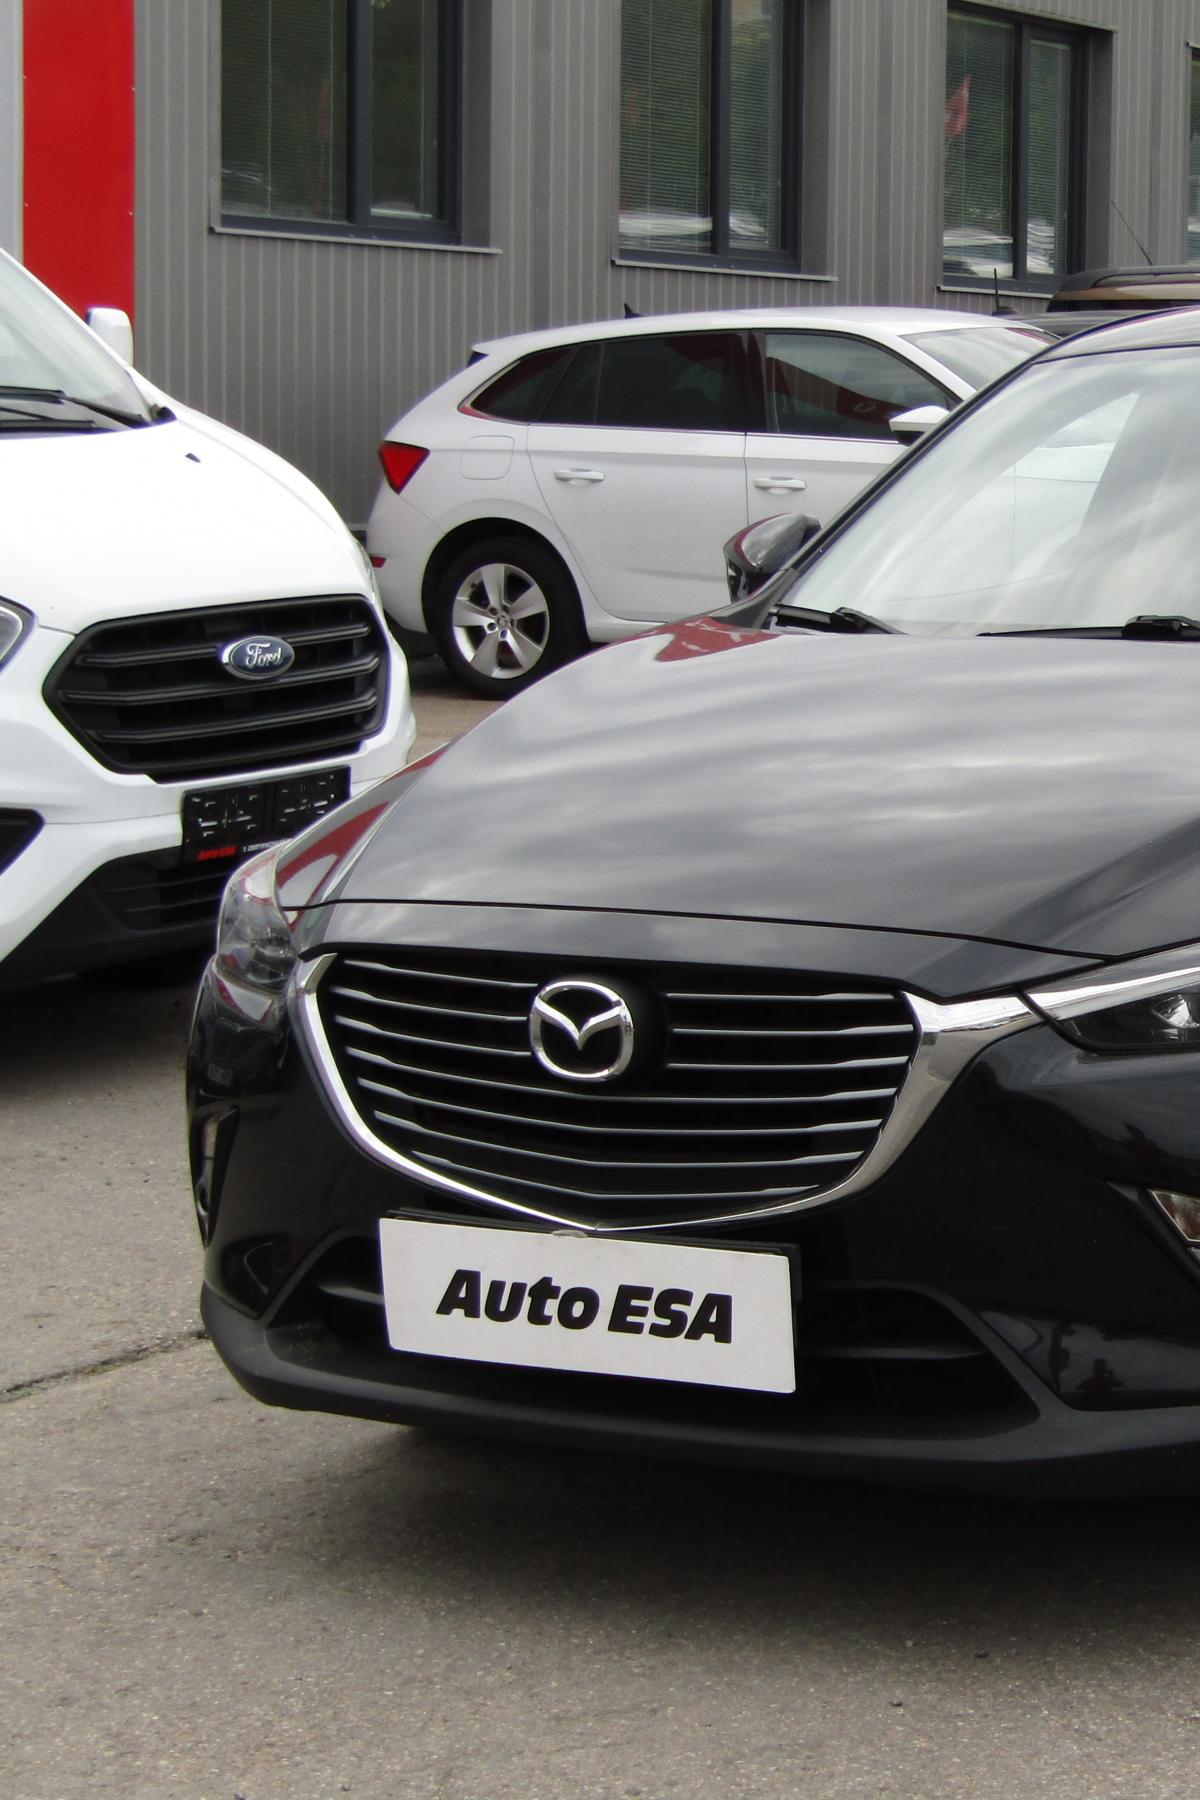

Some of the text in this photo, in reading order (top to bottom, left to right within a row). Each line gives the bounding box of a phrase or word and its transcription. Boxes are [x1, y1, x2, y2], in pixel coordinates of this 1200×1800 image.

[246, 643, 282, 668] Ford
[436, 1269, 732, 1344] Auto ESA
